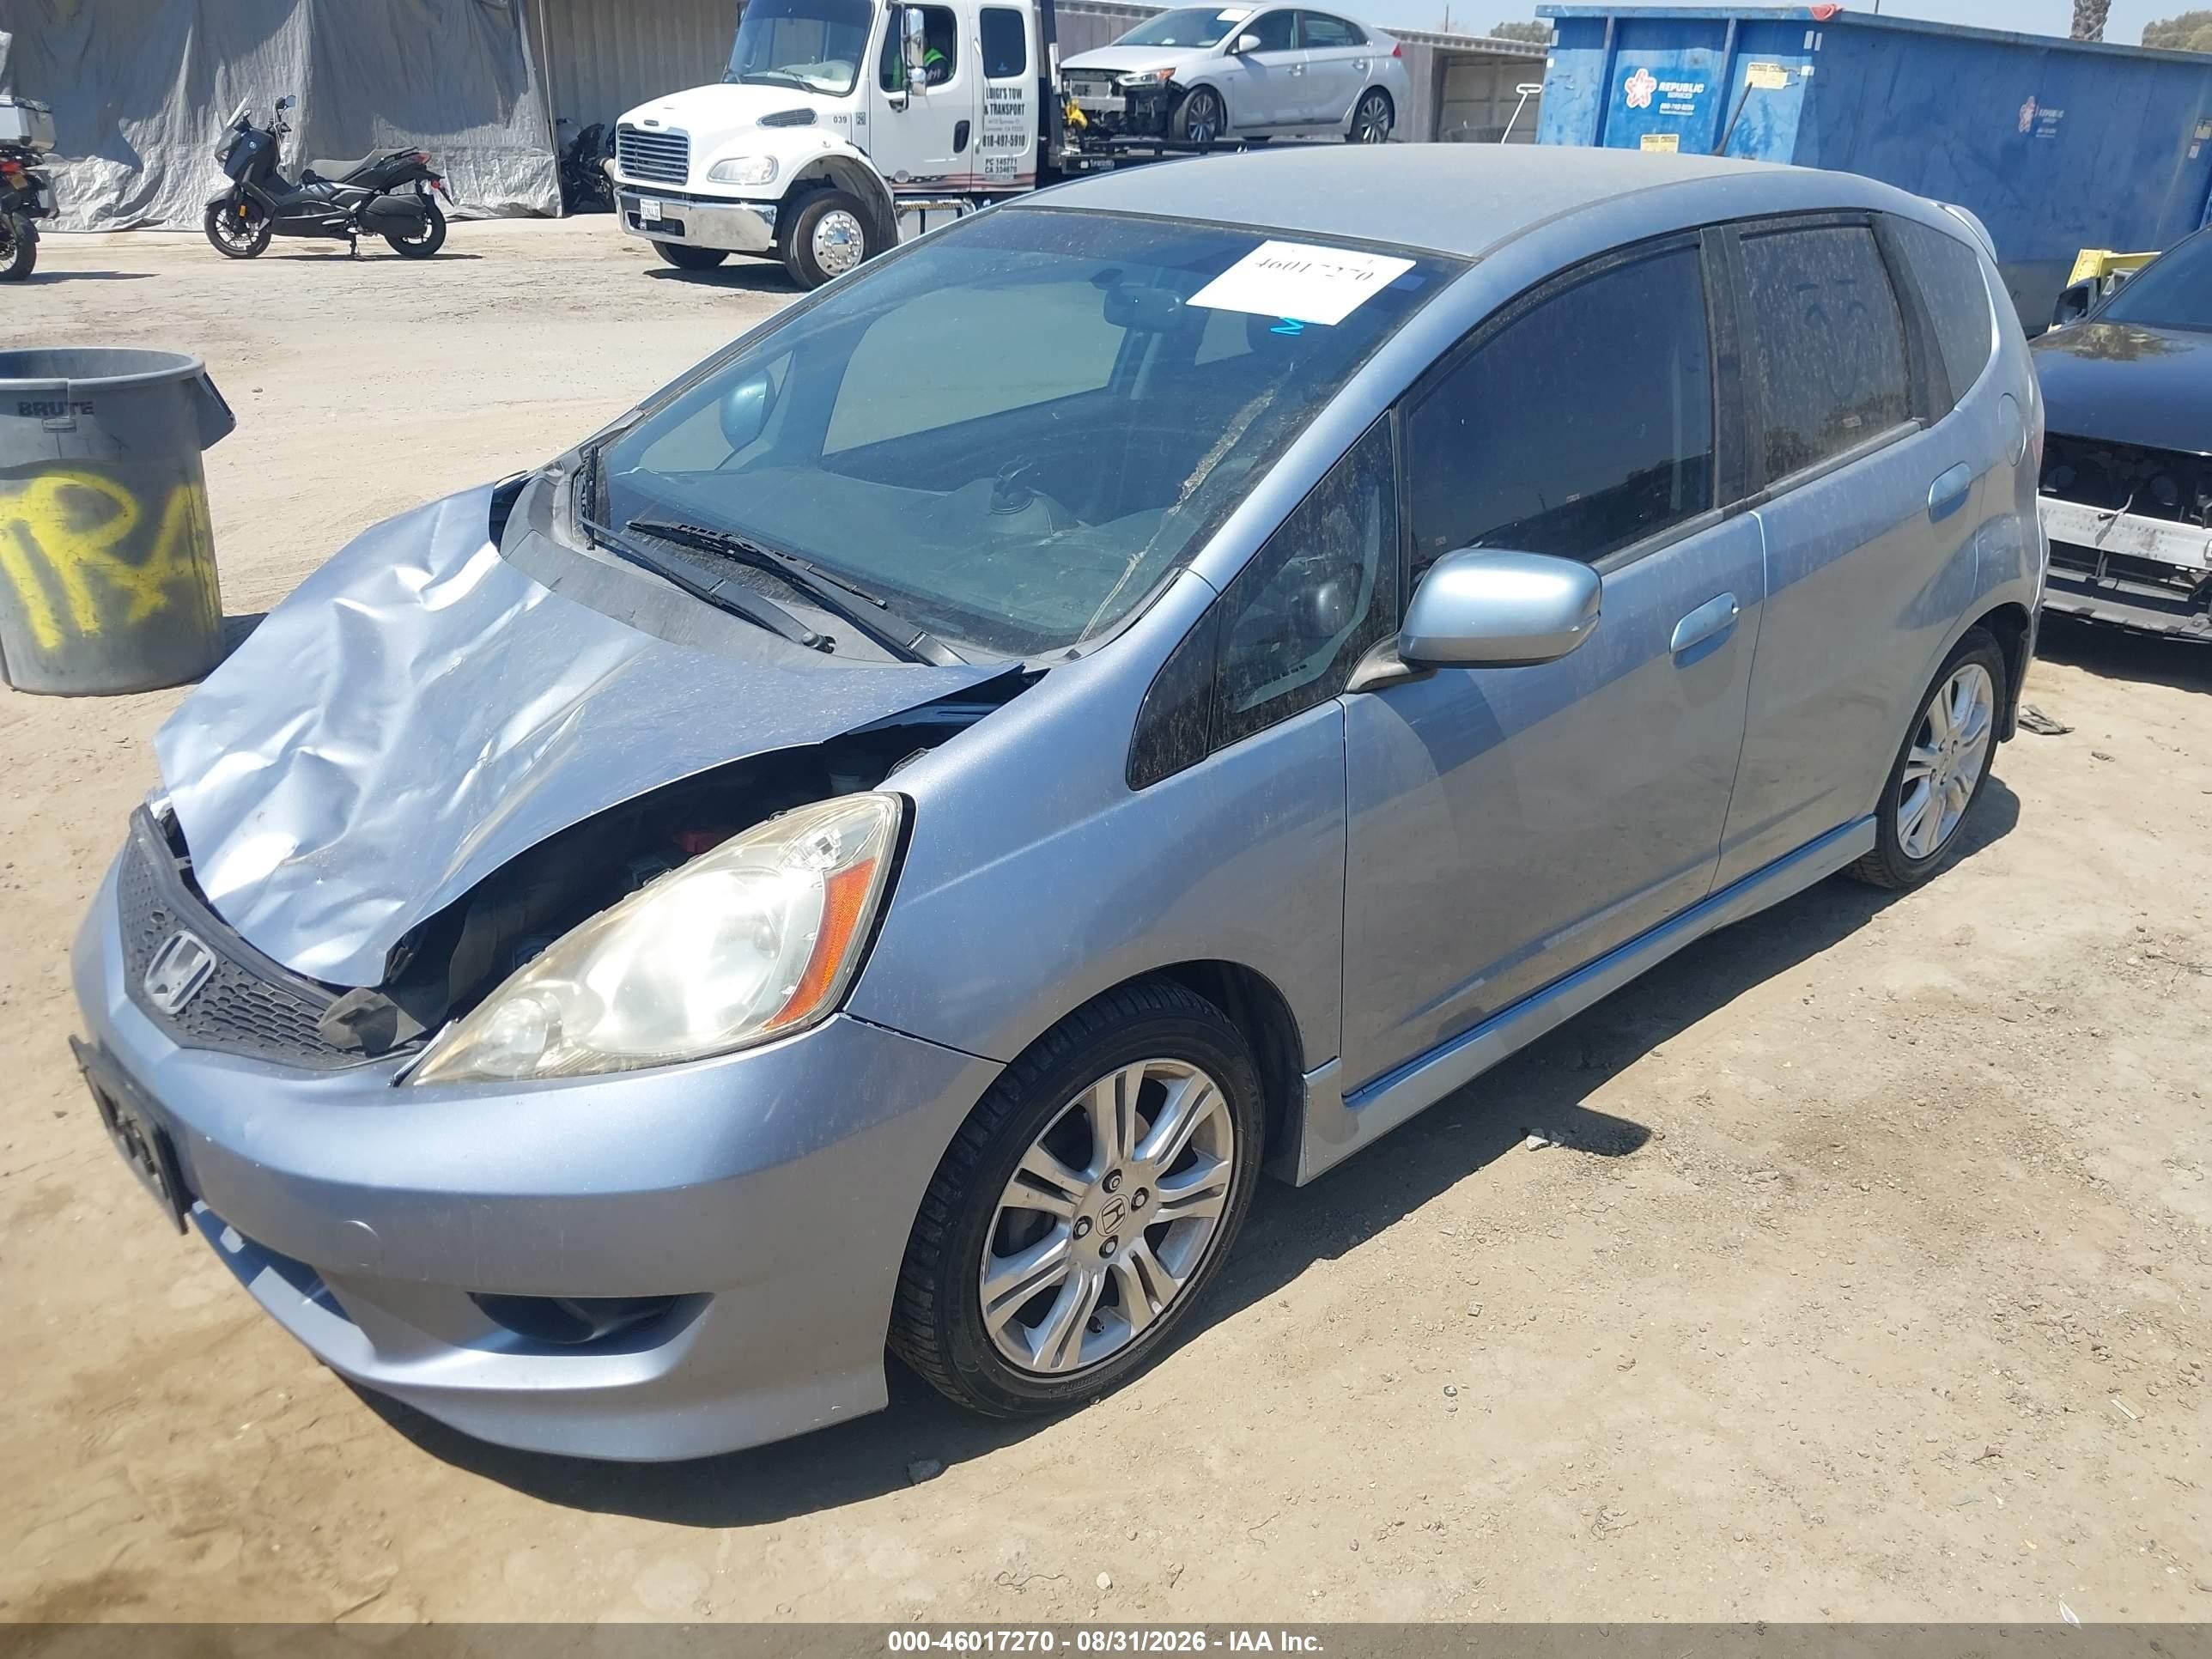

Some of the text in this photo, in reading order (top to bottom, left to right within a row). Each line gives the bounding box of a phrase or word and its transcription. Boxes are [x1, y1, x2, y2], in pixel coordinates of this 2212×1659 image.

[1008, 88, 1023, 100] TOW
[1658, 82, 1705, 94] REPUBLIC
[989, 103, 1025, 116] TRANSPORT
[17, 401, 95, 416] BRUTE
